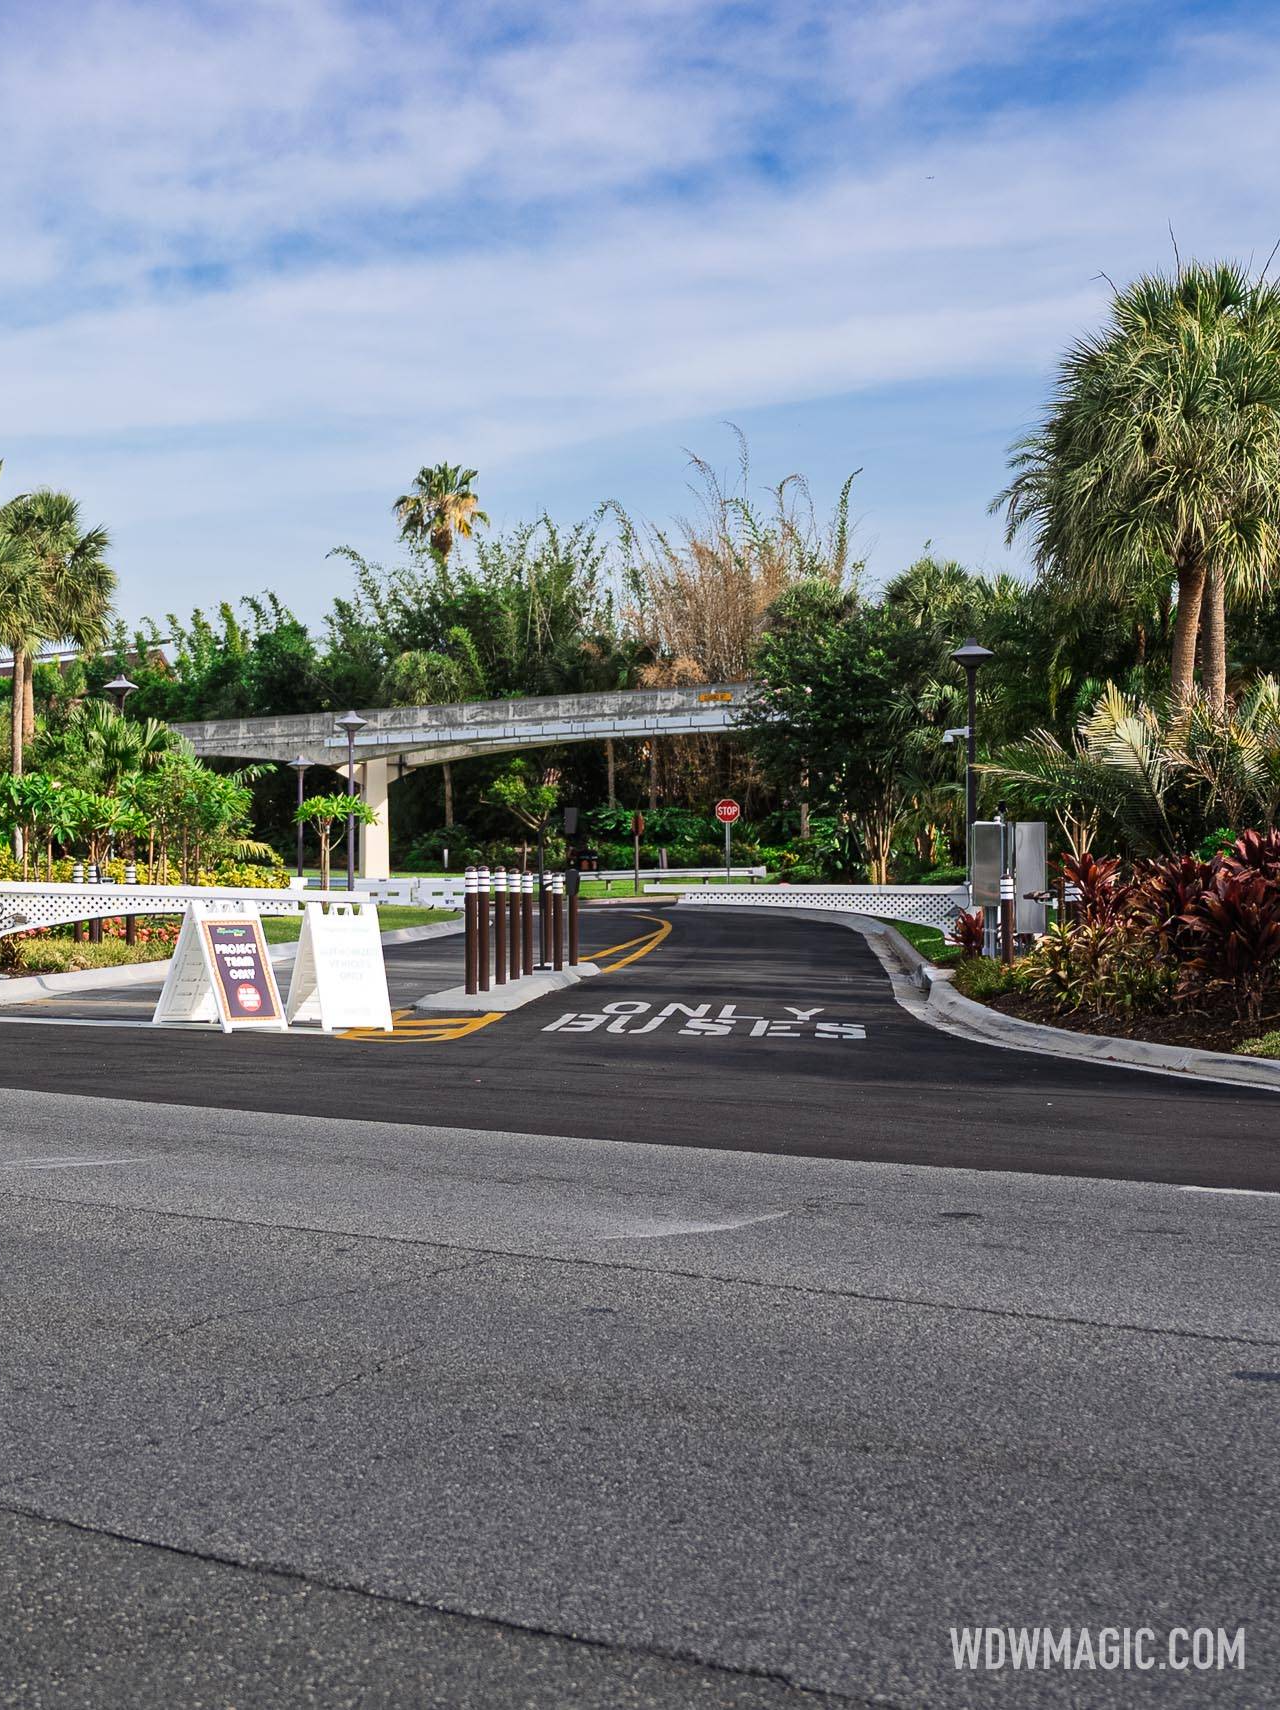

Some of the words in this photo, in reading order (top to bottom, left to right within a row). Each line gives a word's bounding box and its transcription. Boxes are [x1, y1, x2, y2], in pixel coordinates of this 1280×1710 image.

[717, 806, 738, 816] STOP
[214, 943, 257, 955] PROJECT
[224, 956, 255, 967] TEAM
[229, 968, 256, 980] ONLY
[601, 1001, 825, 1021] ONLY
[540, 1012, 867, 1040] BUSES
